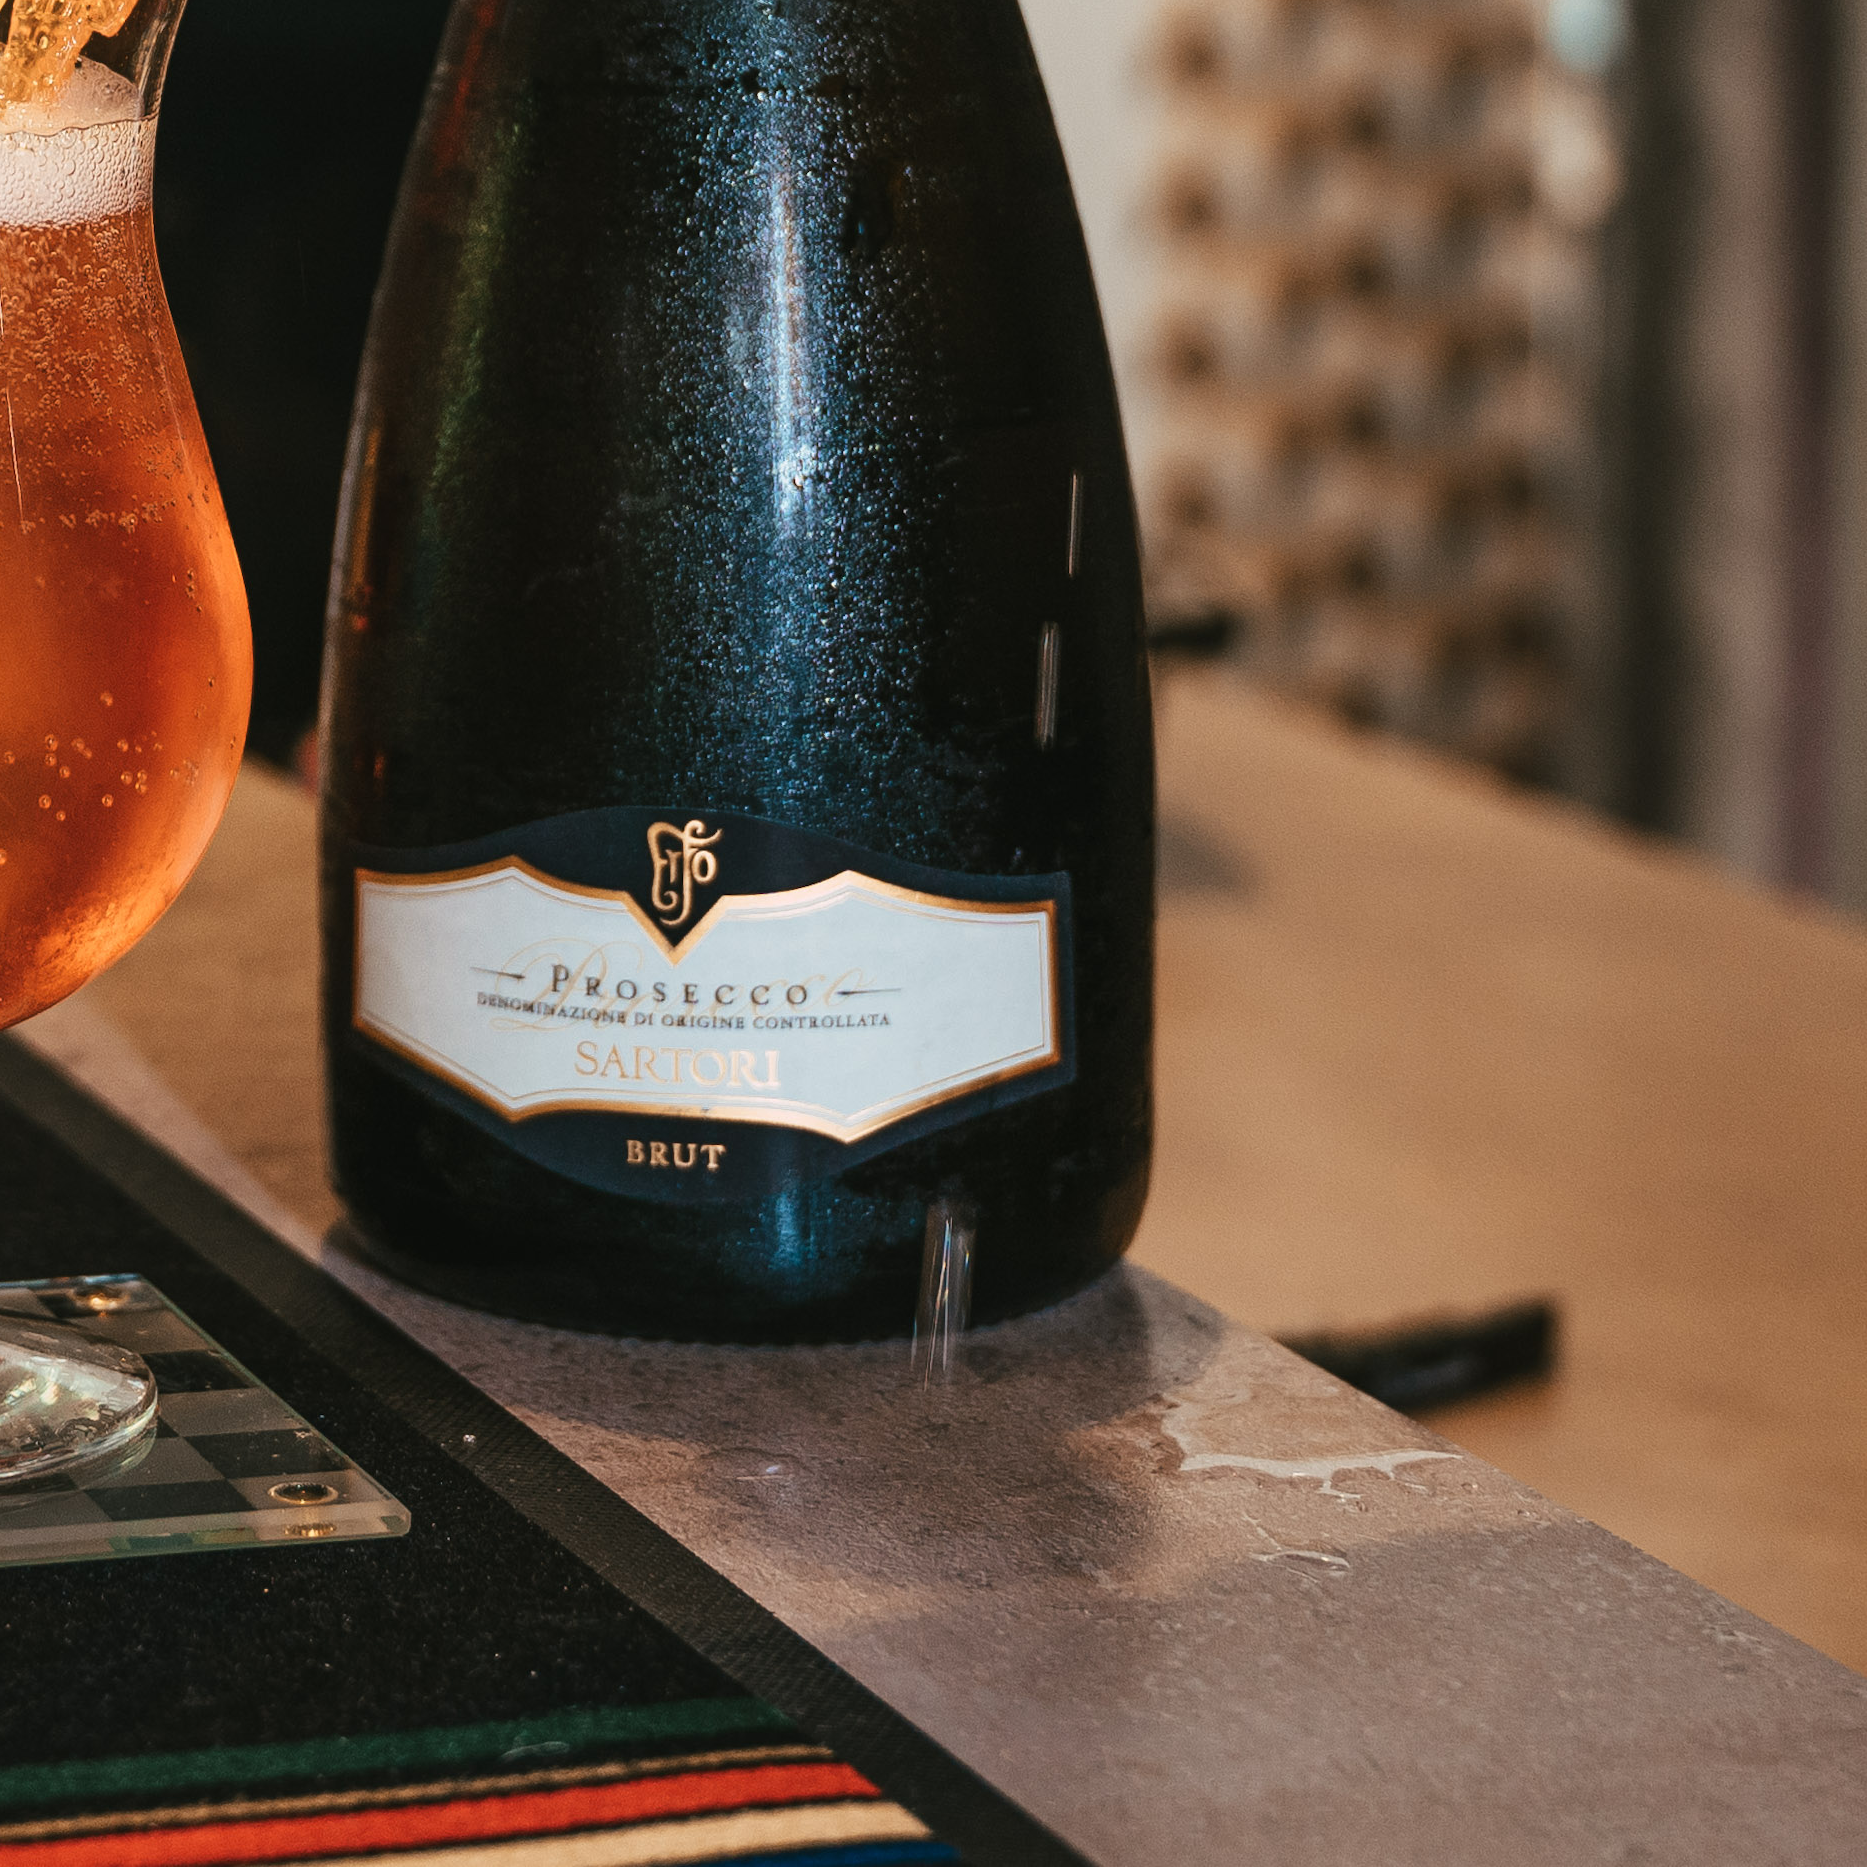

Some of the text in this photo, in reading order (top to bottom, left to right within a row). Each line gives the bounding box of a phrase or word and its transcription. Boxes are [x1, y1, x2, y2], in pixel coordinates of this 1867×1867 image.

[551, 963, 809, 1007] PROSECCO
[476, 990, 892, 1030] DENOMINAZIONE DI ORIGINE CONTROLLATA
[573, 1039, 782, 1091] SARTORI
[625, 1139, 728, 1174] BRUT
